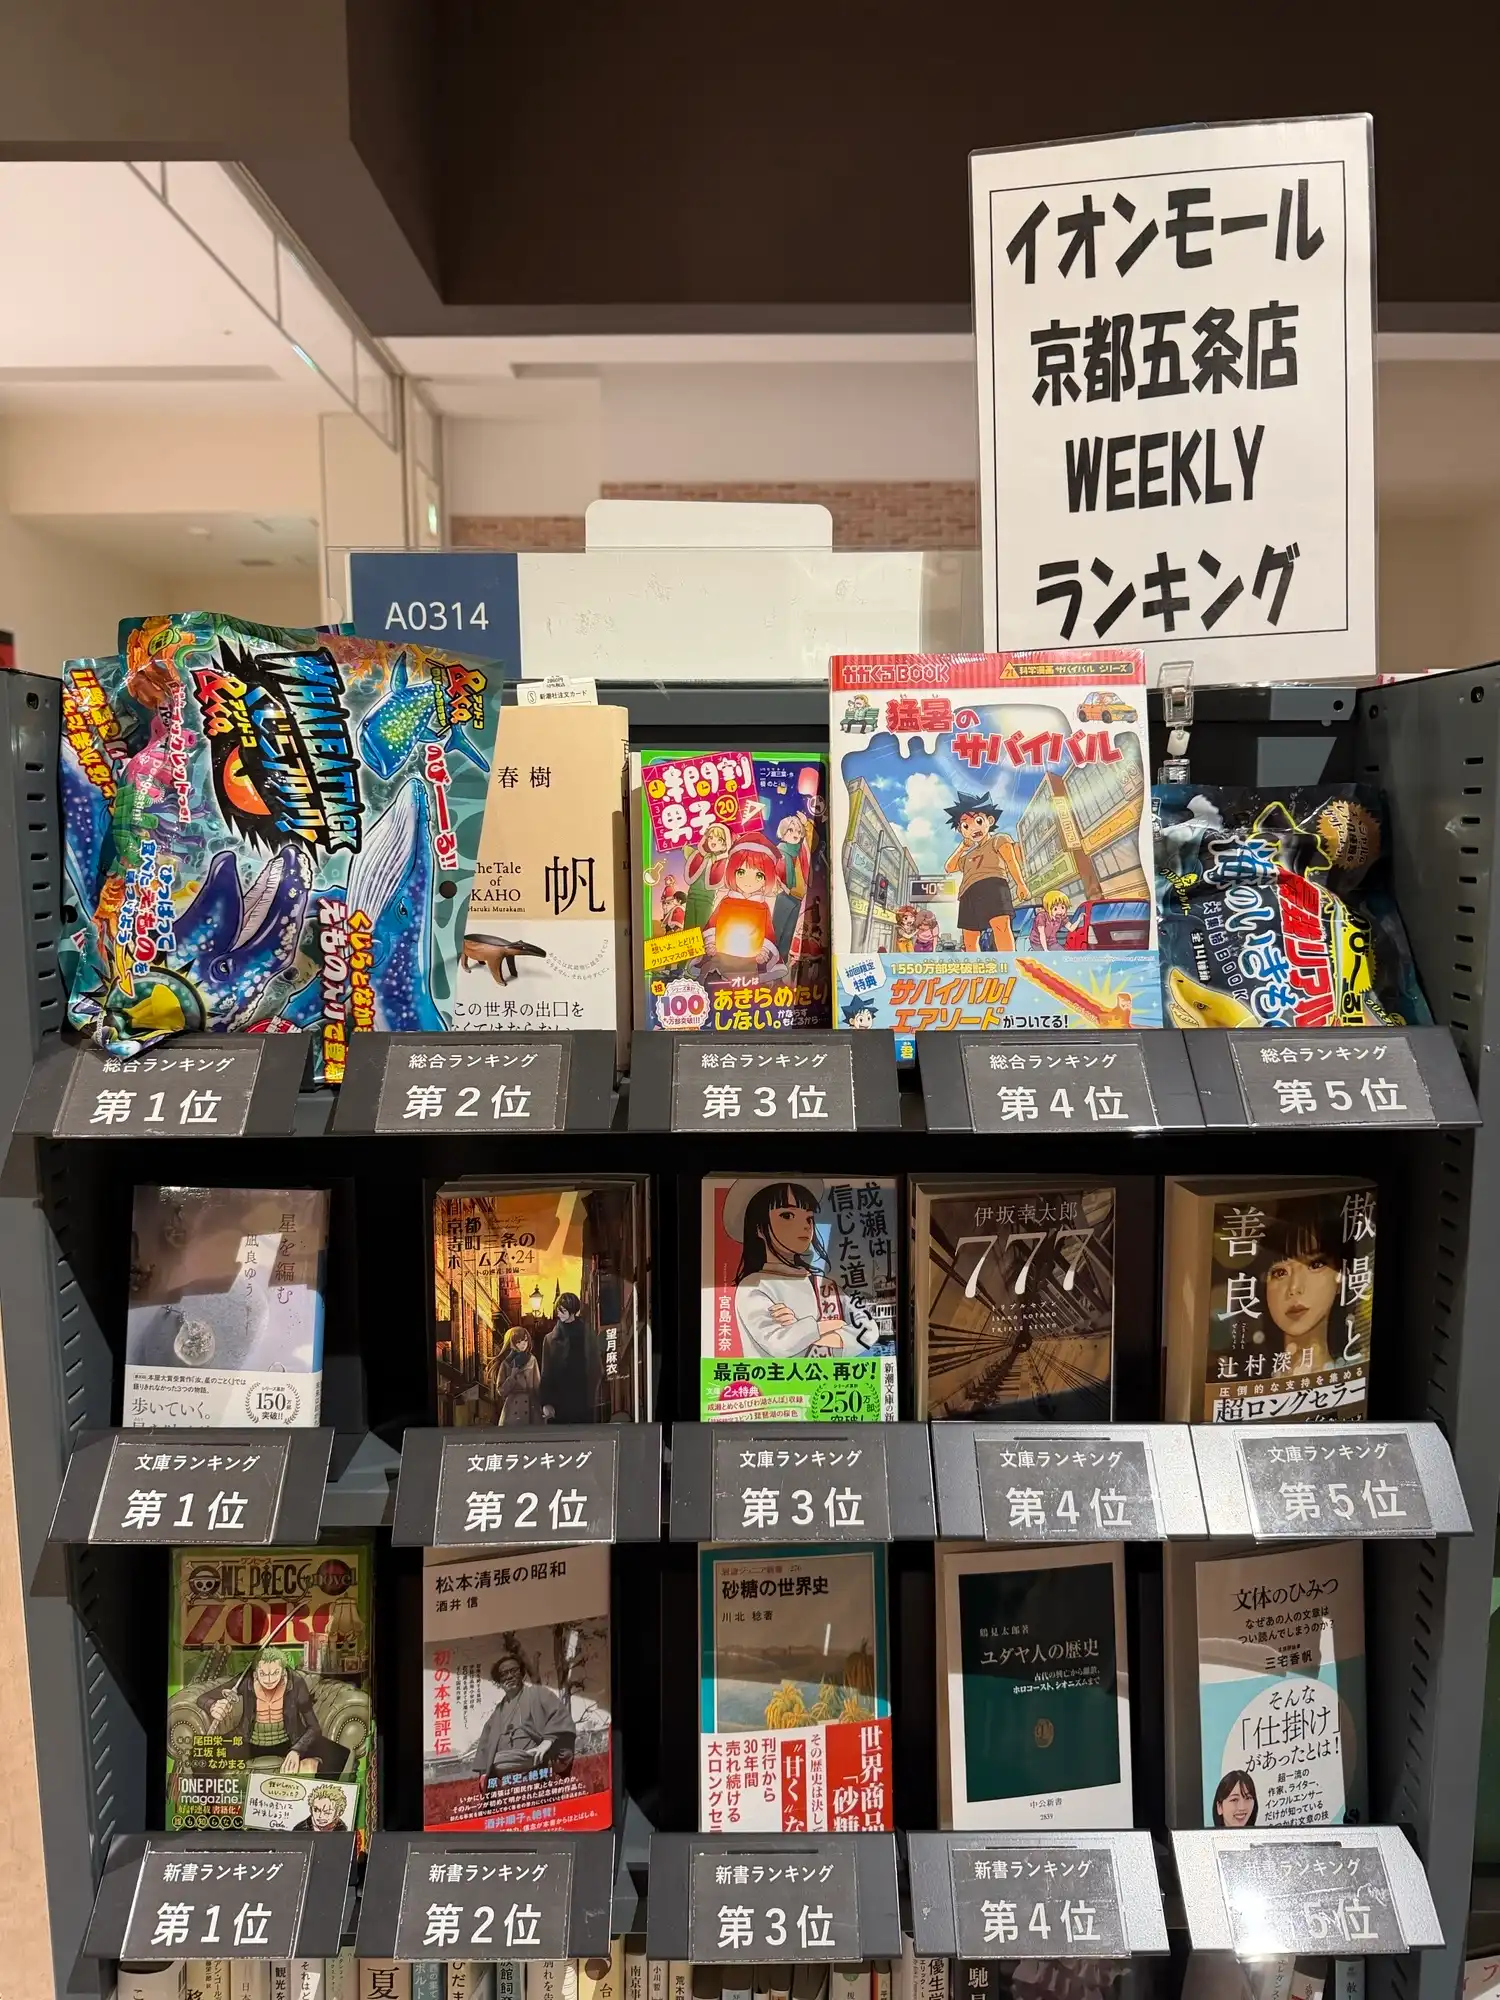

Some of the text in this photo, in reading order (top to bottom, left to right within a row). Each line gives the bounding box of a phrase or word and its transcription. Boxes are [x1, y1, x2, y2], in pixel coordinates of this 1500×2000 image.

[1006, 179, 1324, 284] イオンモール
[1031, 300, 1299, 407] 京都五条店
[1065, 424, 1265, 513] WEEKLY
[1036, 542, 1300, 640] ランキング
[385, 601, 489, 632] A0314
[1099, 663, 1131, 674] シリーズ
[228, 698, 257, 748] アンドコ
[886, 697, 980, 734] 猛暑の
[951, 730, 1124, 768] サバイバル
[662, 801, 735, 843] 男子 20
[490, 876, 502, 886] of
[494, 862, 522, 874] Tale
[471, 889, 521, 902] KAHO
[545, 856, 606, 916] 帆
[158, 865, 175, 951] ひっぱって
[853, 976, 878, 991] 特典
[889, 977, 1018, 1005] サバイバル!
[454, 1001, 585, 1018] この世界の出口を
[662, 996, 706, 1017] 100
[715, 1010, 782, 1030] しない。
[1003, 1014, 1069, 1028] がついてる!
[408, 1052, 538, 1070] 総合ランキング
[701, 1052, 829, 1070] 総合ランキング
[900, 1044, 914, 1060] 君
[989, 1052, 1118, 1071] 総合ランキング
[1260, 1044, 1388, 1064] 総合ランキング
[103, 1056, 235, 1075] 総合ランキング
[89, 1088, 222, 1126] 第1位
[403, 1084, 533, 1120] 第2位
[703, 1082, 829, 1120] 第3位
[996, 1085, 1129, 1121] 第4位
[1272, 1076, 1409, 1113] 第5位
[447, 1217, 482, 1234] 京都
[858, 1182, 889, 1257] 成瀬は
[974, 1201, 1078, 1227] 伊坂幸太郎
[447, 1232, 536, 1252] 寺町三条の
[244, 1234, 259, 1297] 凪良ゆう
[274, 1213, 297, 1304] 星を編む
[828, 1184, 872, 1351] 信じた道をいく
[955, 1228, 1095, 1299] 777
[1217, 1206, 1266, 1321] 善良
[1339, 1191, 1377, 1361] 傲慢と
[718, 1295, 732, 1351] 宮島未奈
[992, 1325, 1024, 1333] TRIPLE
[605, 1328, 618, 1375] 望月麻衣
[1217, 1347, 1315, 1379] 辻村深月
[714, 1362, 877, 1381] 最高の主人公、再び!
[1219, 1367, 1363, 1398] 圧倒的な支持を集める
[256, 1393, 286, 1411] 150
[723, 1386, 760, 1397] 2大特典
[820, 1390, 862, 1413] 250
[1215, 1380, 1367, 1423] 超ロングセラー
[131, 1397, 210, 1420] 歩いていく。
[262, 1411, 283, 1420] 突破!!
[134, 1452, 261, 1472] 文庫ランキング
[467, 1451, 593, 1473] 文庫ランキング
[739, 1448, 863, 1469] 文庫ランキング
[1000, 1448, 1123, 1469] 文庫ランキング
[1268, 1442, 1392, 1465] 文庫ランキング
[121, 1488, 249, 1530] 第1位
[464, 1488, 589, 1530] 第2位
[741, 1486, 865, 1528] 第3位
[1005, 1486, 1132, 1528] 第4位
[1278, 1481, 1408, 1520] 第5位
[435, 1560, 567, 1594] 松本清張の昭和
[721, 1575, 829, 1600] 砂糖の世界史
[436, 1596, 478, 1612] 酒井 信
[1230, 1578, 1339, 1612] 文体のひみつ
[721, 1611, 745, 1623] 川北
[1245, 1606, 1330, 1630] なぜあの人の文章は
[1238, 1619, 1335, 1645] つい読んでしまうのか?
[980, 1638, 1100, 1665] ユダヤ人の歴史
[1264, 1650, 1313, 1670] 三宅香帆
[1013, 1677, 1100, 1694] ホロコースト、シオニズムまで
[1269, 1685, 1316, 1710] そんな
[432, 1648, 453, 1756] 初の本格評伝
[1241, 1704, 1341, 1750] 「仕掛け」
[193, 1736, 243, 1746] 尾田栄一郎
[208, 1760, 247, 1769] なかまる
[743, 1739, 759, 1788] 30年間
[1245, 1737, 1341, 1773] があったとは!
[725, 1740, 741, 1823] 売れ続ける
[761, 1737, 776, 1803] 刊行から
[1278, 1768, 1310, 1783] 超一流の
[206, 1778, 239, 1794] PIECE
[1268, 1780, 1320, 1797] 作家、ライター、
[1030, 1798, 1063, 1809] 中公新書
[1265, 1791, 1324, 1809] インフルエンサー
[1265, 1801, 1324, 1821] だけが知っている
[162, 1862, 284, 1881] 新書ランキング
[428, 1862, 549, 1882] 新書ランキング
[714, 1863, 834, 1884] 新書ランキング
[973, 1859, 1095, 1880] 新書ランキング
[151, 1902, 273, 1946] 第1位
[422, 1902, 542, 1946] 第2位
[717, 1903, 836, 1948] 第3位
[980, 1899, 1102, 1944] 第4位
[366, 1966, 399, 1999] 夏
[600, 1983, 613, 1998] 台
